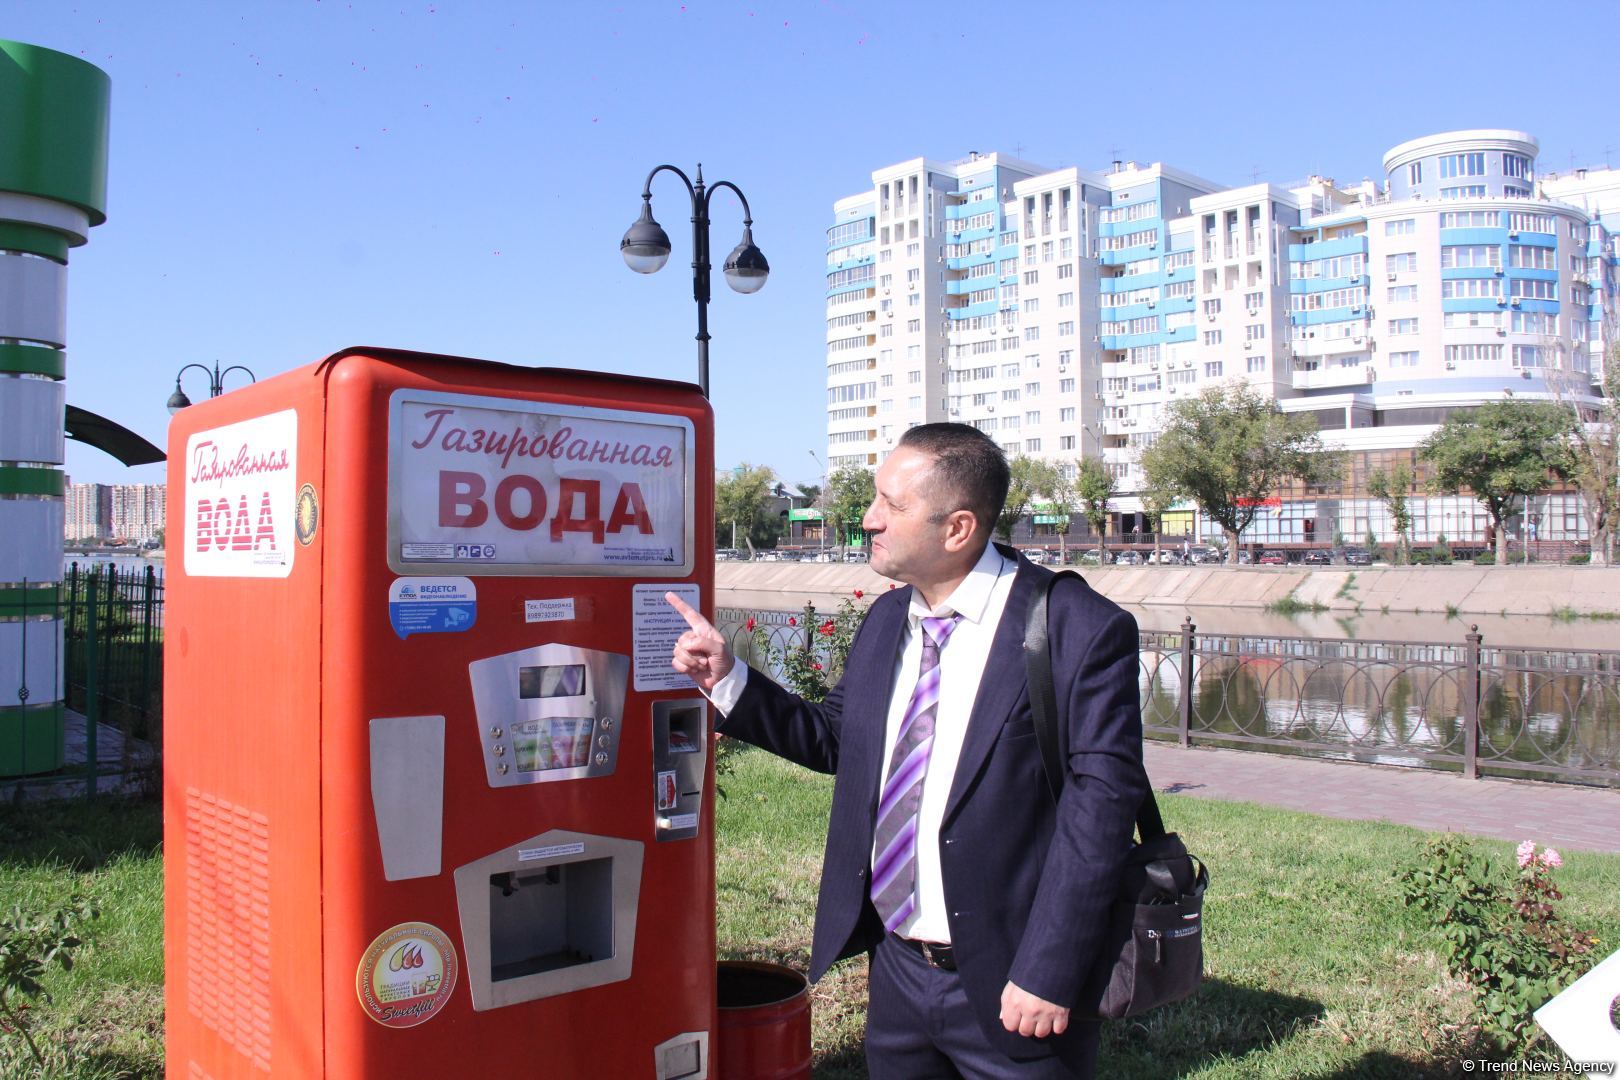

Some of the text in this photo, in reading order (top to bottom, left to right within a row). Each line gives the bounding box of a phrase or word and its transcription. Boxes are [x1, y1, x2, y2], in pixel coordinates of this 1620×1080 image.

[191, 440, 290, 489] Газированная
[411, 409, 674, 469] Газированная
[196, 491, 277, 552] ВОДА
[438, 469, 656, 545] ВОДА
[420, 585, 457, 594] ВЕДЕТСЯ
[380, 998, 436, 1021] Sweetfill
